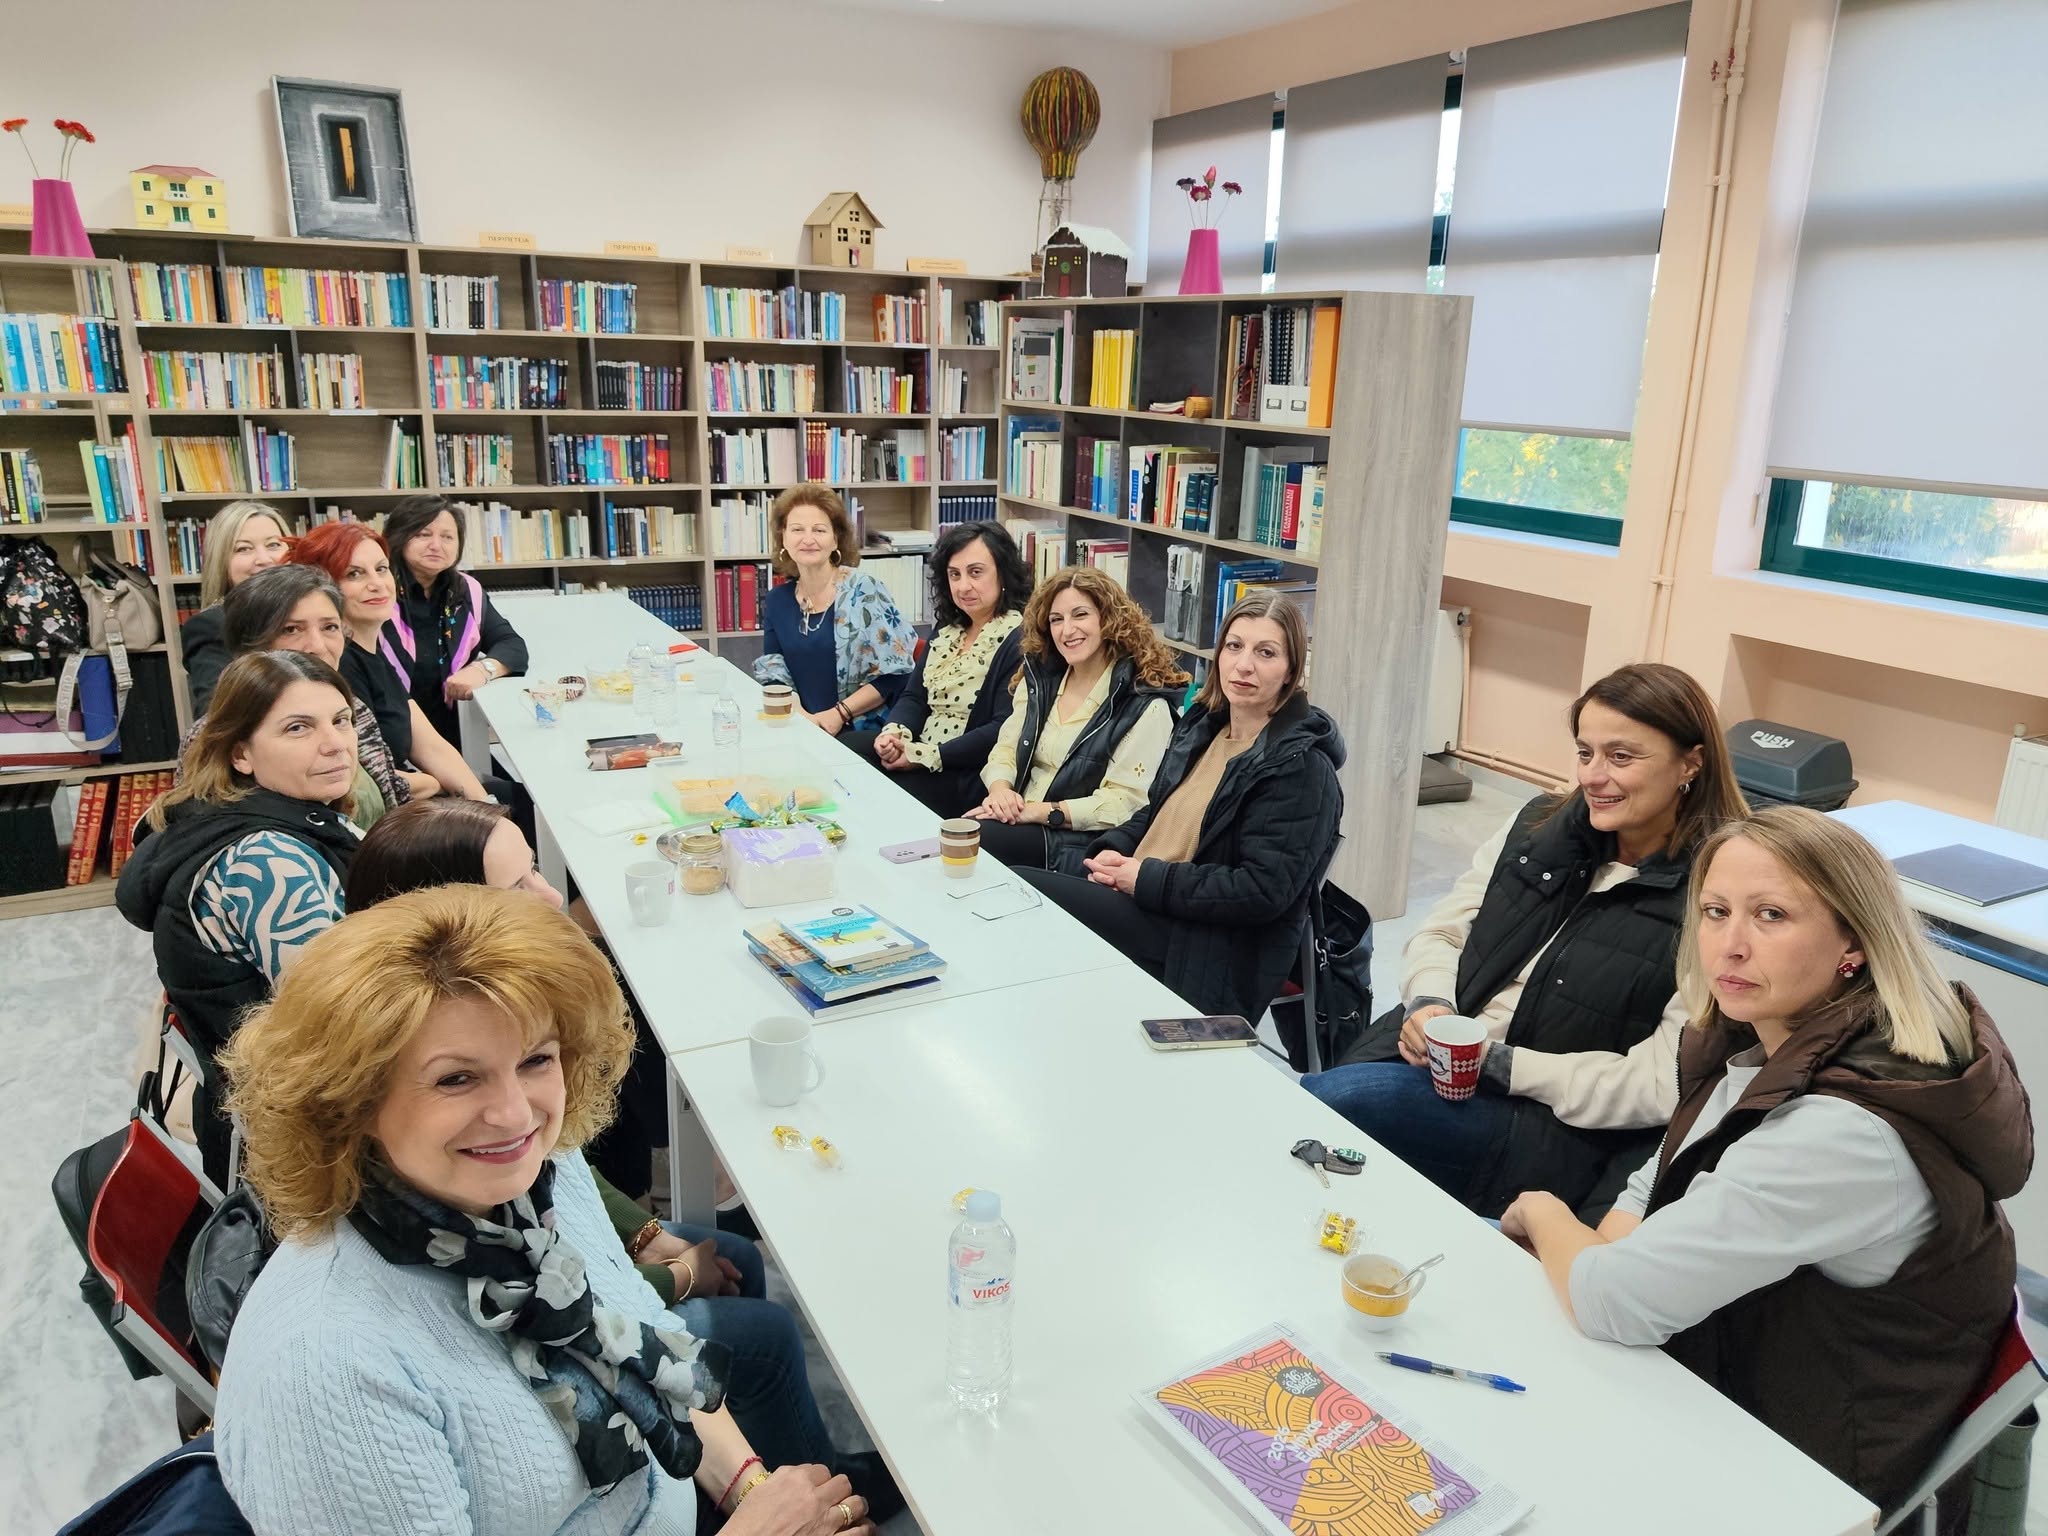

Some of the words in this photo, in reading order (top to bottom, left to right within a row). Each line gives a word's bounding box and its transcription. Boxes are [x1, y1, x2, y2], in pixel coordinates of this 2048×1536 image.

[1750, 730, 1796, 748] PUSH
[973, 1281, 1010, 1298] VIKOS
[1267, 1427, 1290, 1460] 2026
